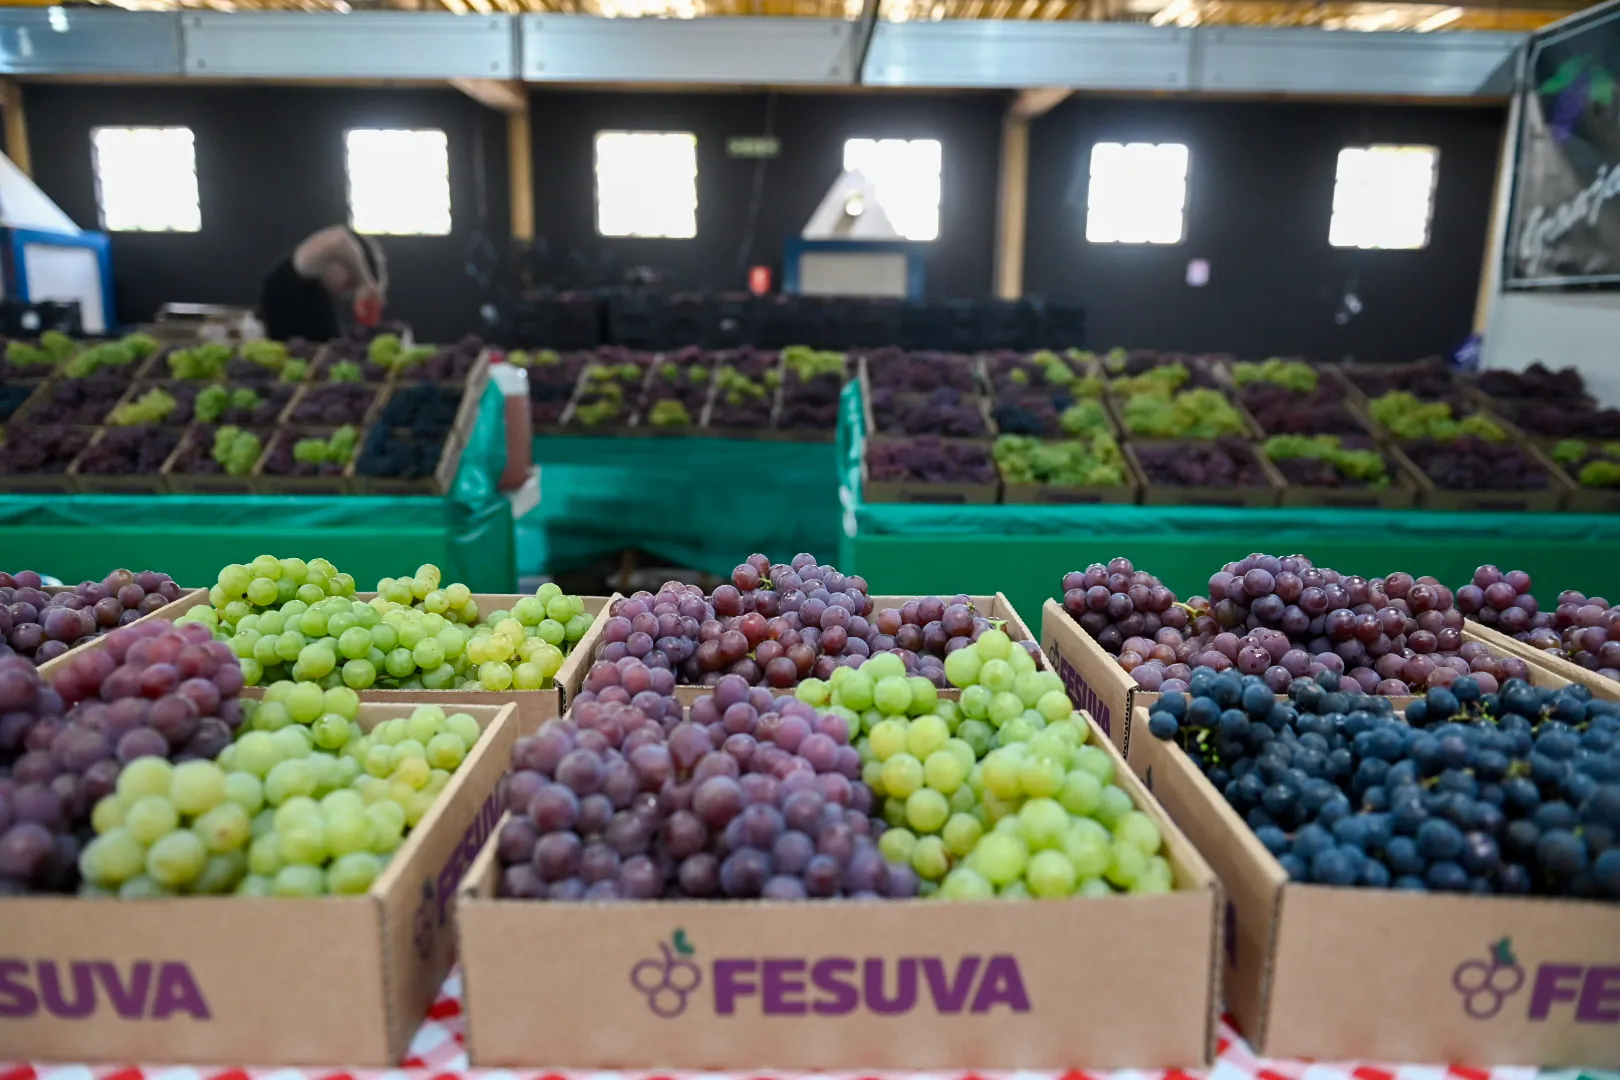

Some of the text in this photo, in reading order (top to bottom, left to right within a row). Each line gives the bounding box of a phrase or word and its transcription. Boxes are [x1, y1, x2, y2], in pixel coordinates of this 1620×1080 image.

[438, 776, 506, 928] FESUV
[0, 959, 212, 1020] SUVA
[712, 954, 1032, 1016] FESUVA
[1527, 963, 1620, 1023] FE
